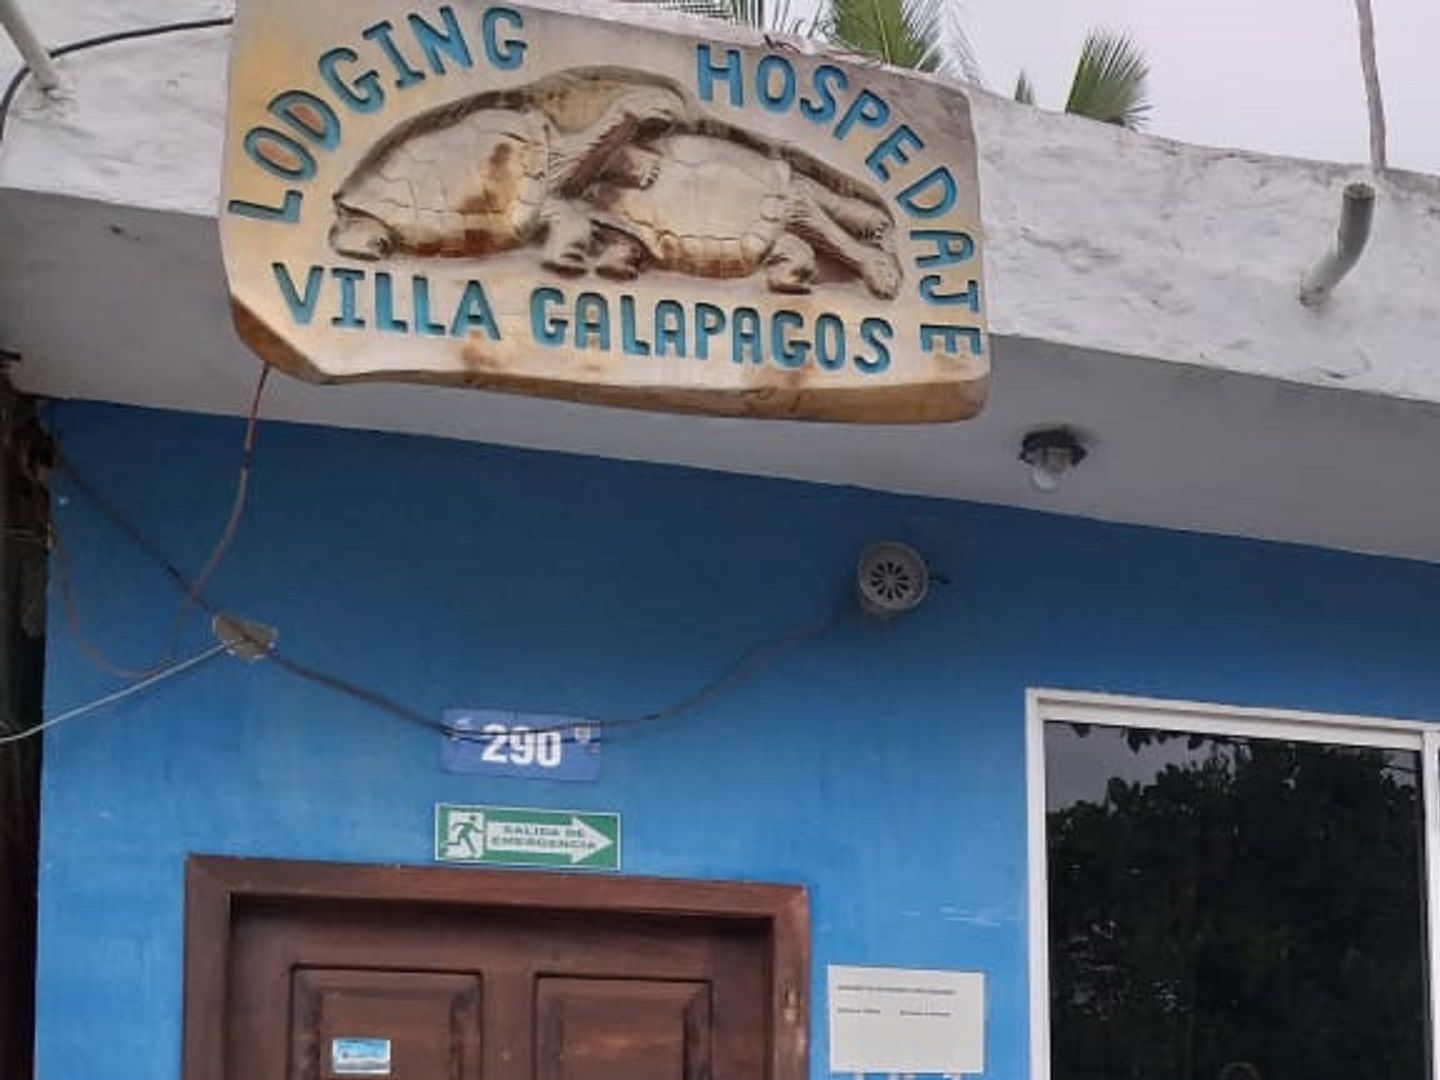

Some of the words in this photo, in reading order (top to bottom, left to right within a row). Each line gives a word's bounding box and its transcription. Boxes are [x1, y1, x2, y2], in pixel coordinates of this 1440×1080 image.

[228, 6, 527, 225] LODGING
[696, 43, 983, 356] HOSPEDAJE
[272, 261, 501, 340] VILLA
[530, 286, 894, 373] GALAPAGOS
[481, 723, 562, 767] 290
[491, 836, 597, 849] EMERGENCIA
[503, 824, 560, 836] SALIDA
[564, 828, 585, 838] DE
